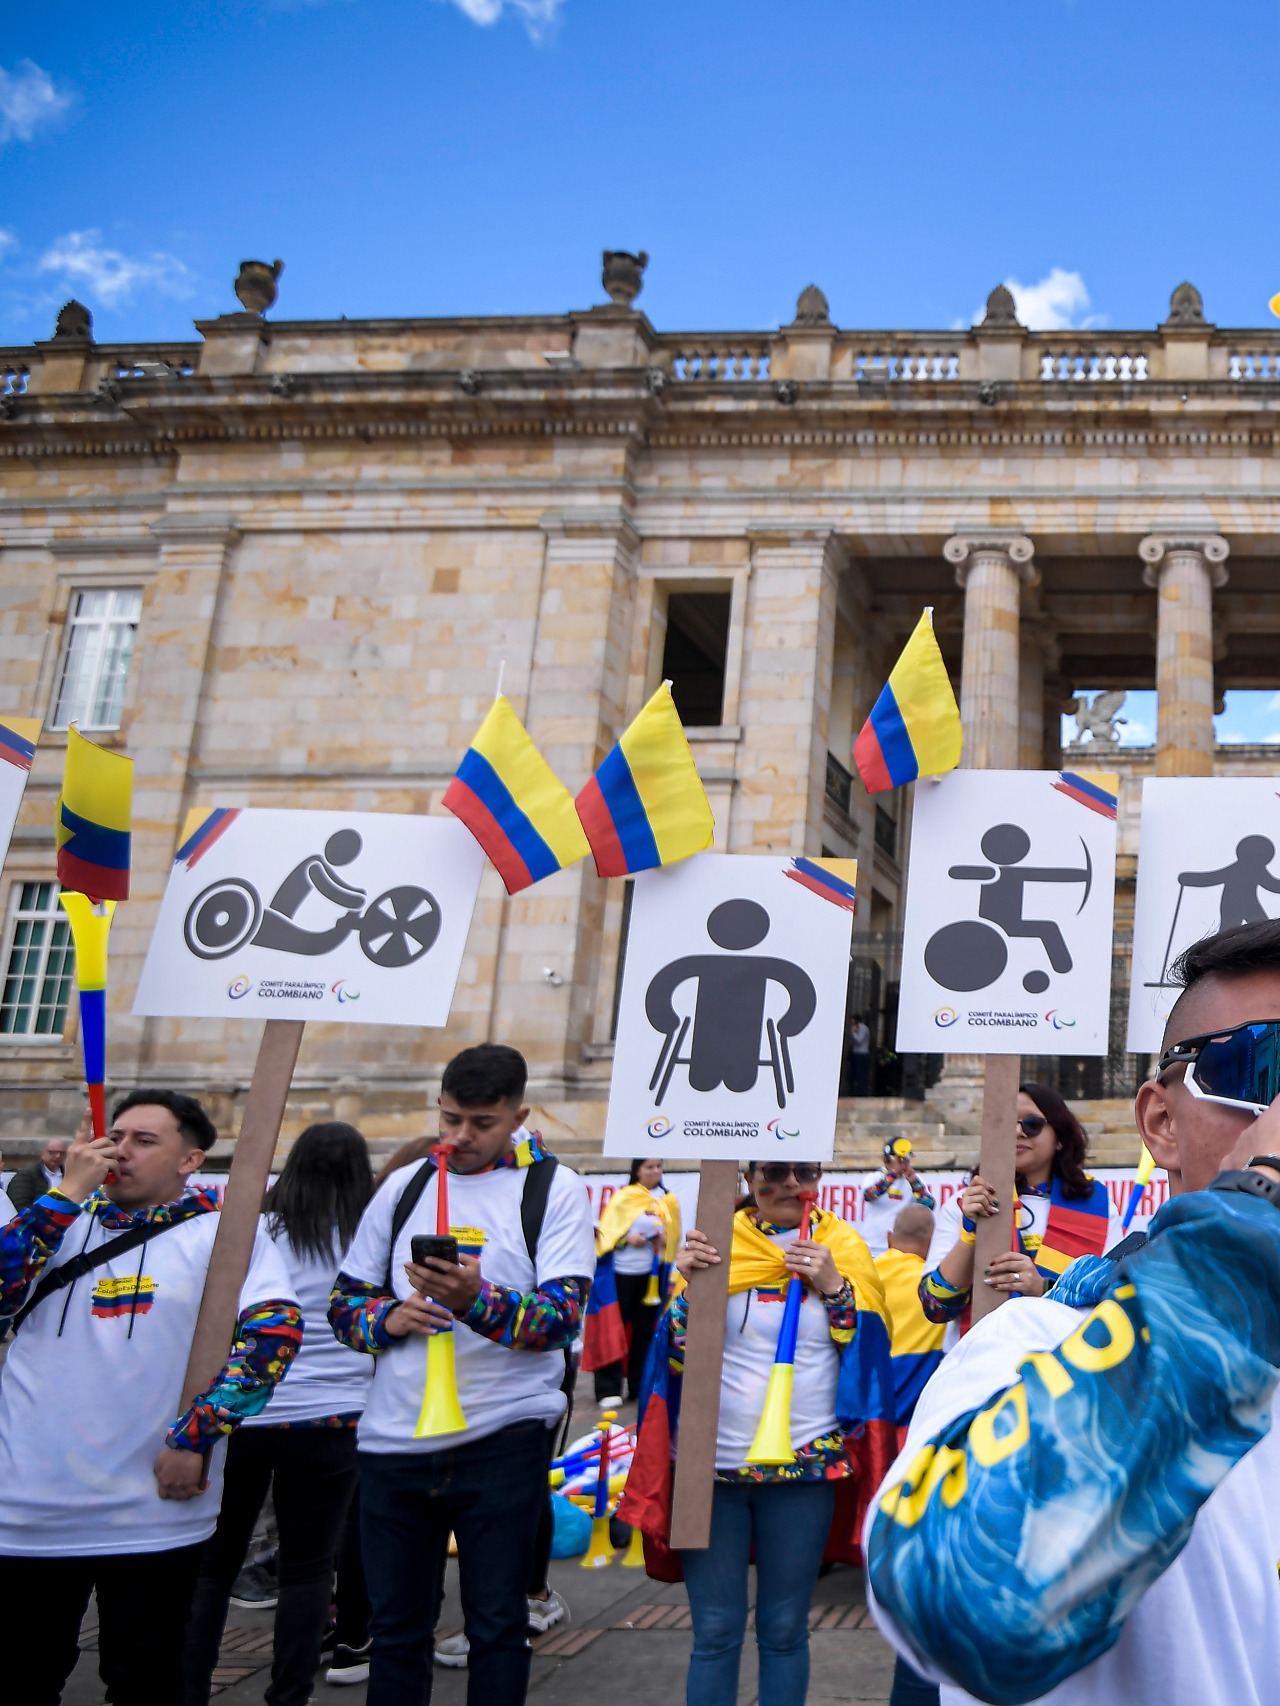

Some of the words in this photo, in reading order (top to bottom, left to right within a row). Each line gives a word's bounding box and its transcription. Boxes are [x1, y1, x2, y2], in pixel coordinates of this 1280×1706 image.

[258, 988, 323, 1000] COLOMBIANO
[994, 1010, 1038, 1018] PARALÍMPICO
[968, 1018, 1038, 1027] COLOMBIANO
[712, 1120, 760, 1128] PARALÍMPICO
[683, 1128, 759, 1138] COLOMBIANO
